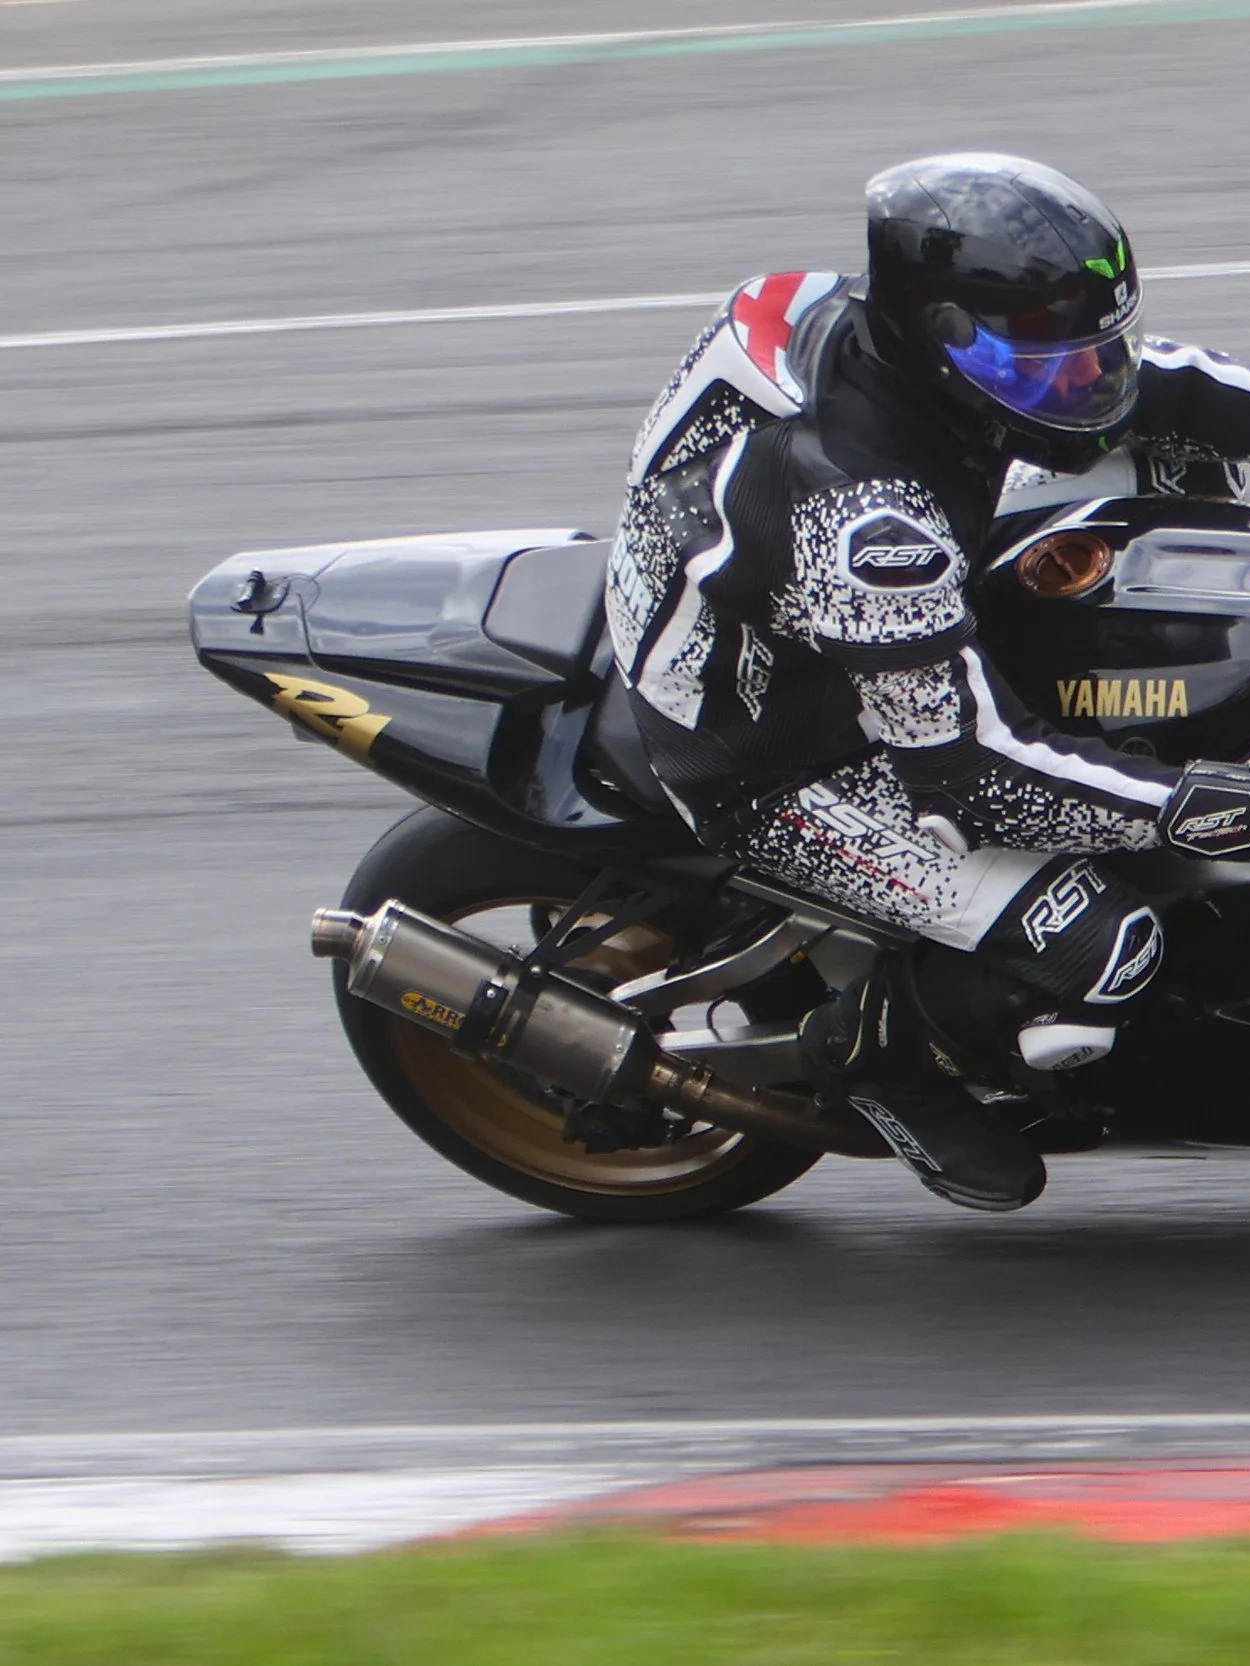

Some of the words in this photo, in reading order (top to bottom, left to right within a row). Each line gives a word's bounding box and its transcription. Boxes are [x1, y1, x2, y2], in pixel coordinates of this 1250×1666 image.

[852, 543, 942, 568] RST
[1057, 679, 1189, 718] YAMAHA
[1175, 807, 1247, 836] RST
[1021, 858, 1107, 954] RST
[1107, 924, 1158, 993] RST
[847, 1095, 943, 1173] RST
